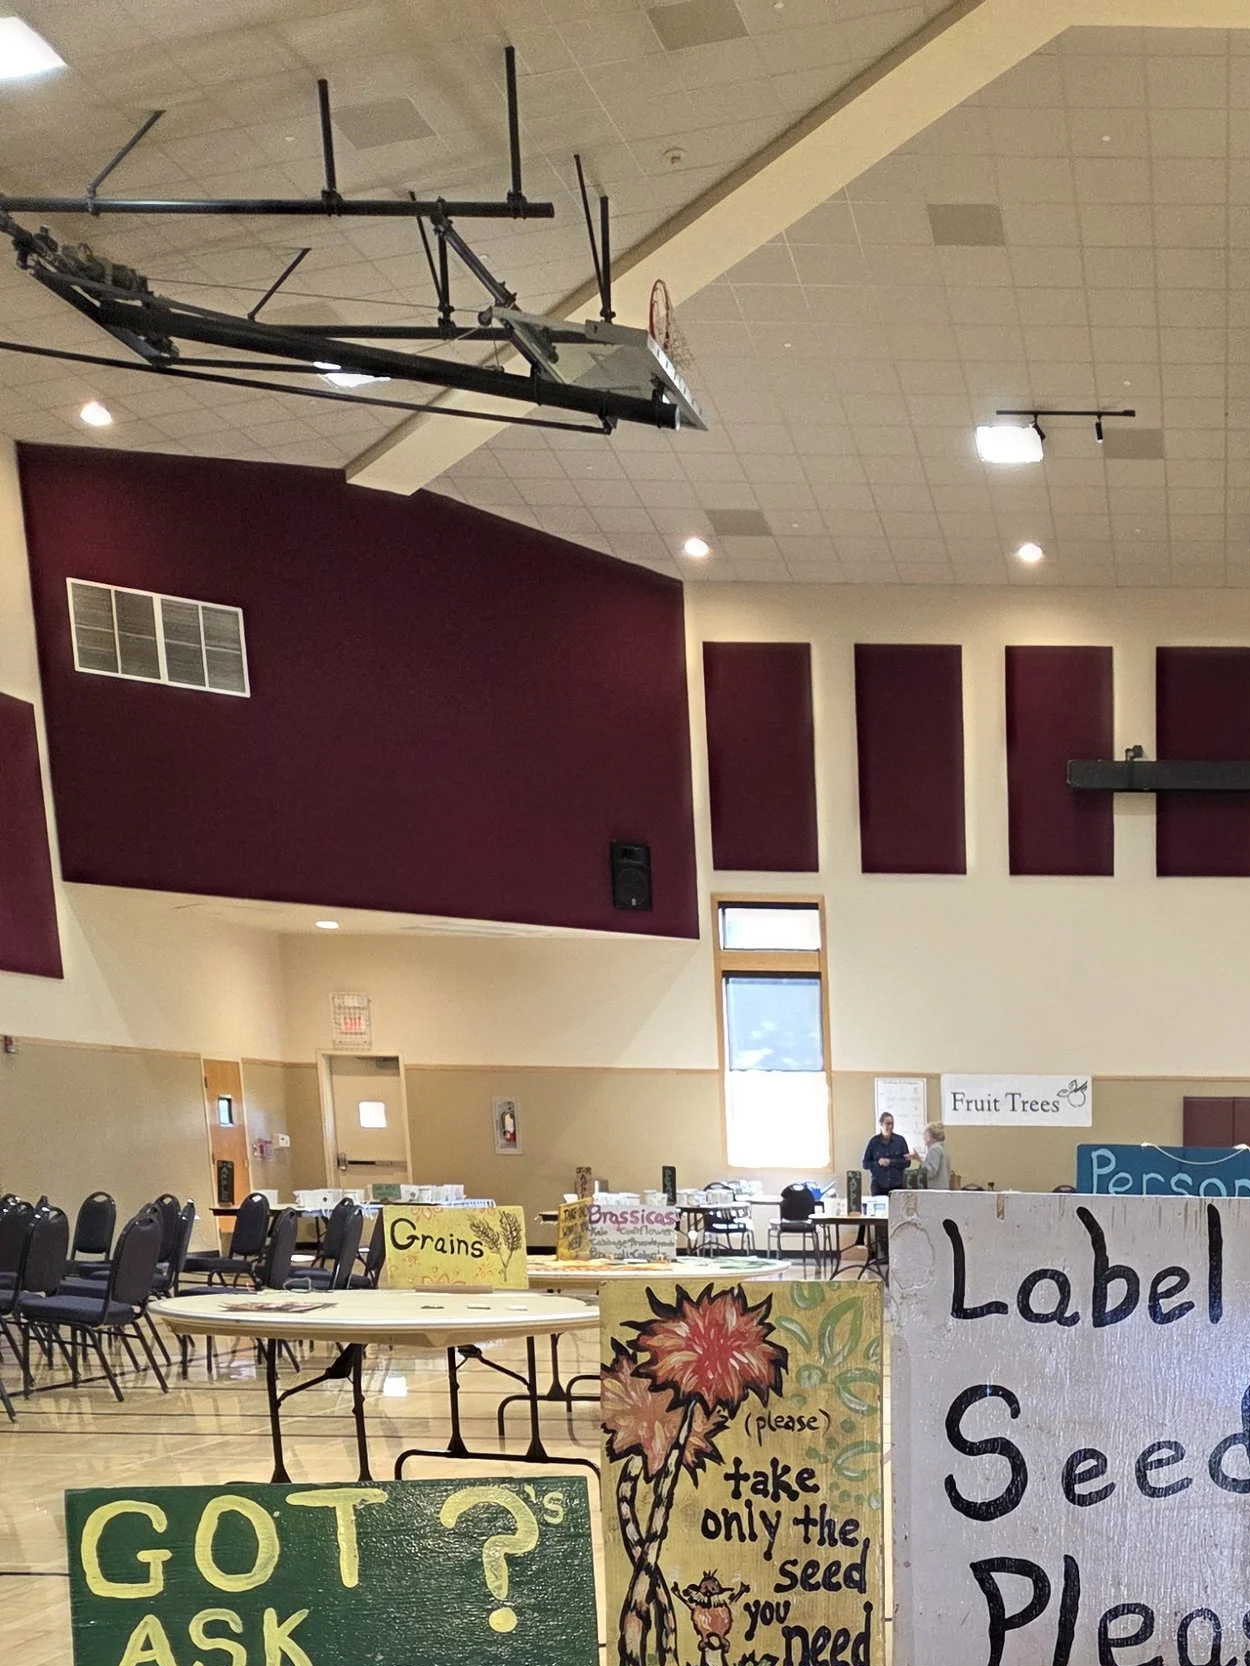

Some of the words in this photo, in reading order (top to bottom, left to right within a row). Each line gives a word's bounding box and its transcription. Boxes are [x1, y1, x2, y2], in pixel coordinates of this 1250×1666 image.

[950, 1091, 1000, 1112] Fruit
[1005, 1091, 1060, 1113] Trees
[588, 1204, 676, 1226] Brassicas
[390, 1217, 484, 1258] Grains
[942, 1204, 1223, 1328] Label
[744, 1408, 831, 1447] (please)
[723, 1456, 821, 1502] take
[81, 1487, 388, 1599] GOT
[701, 1498, 782, 1561] only
[793, 1502, 862, 1549] the
[773, 1537, 871, 1594] seed
[743, 1600, 792, 1641] you
